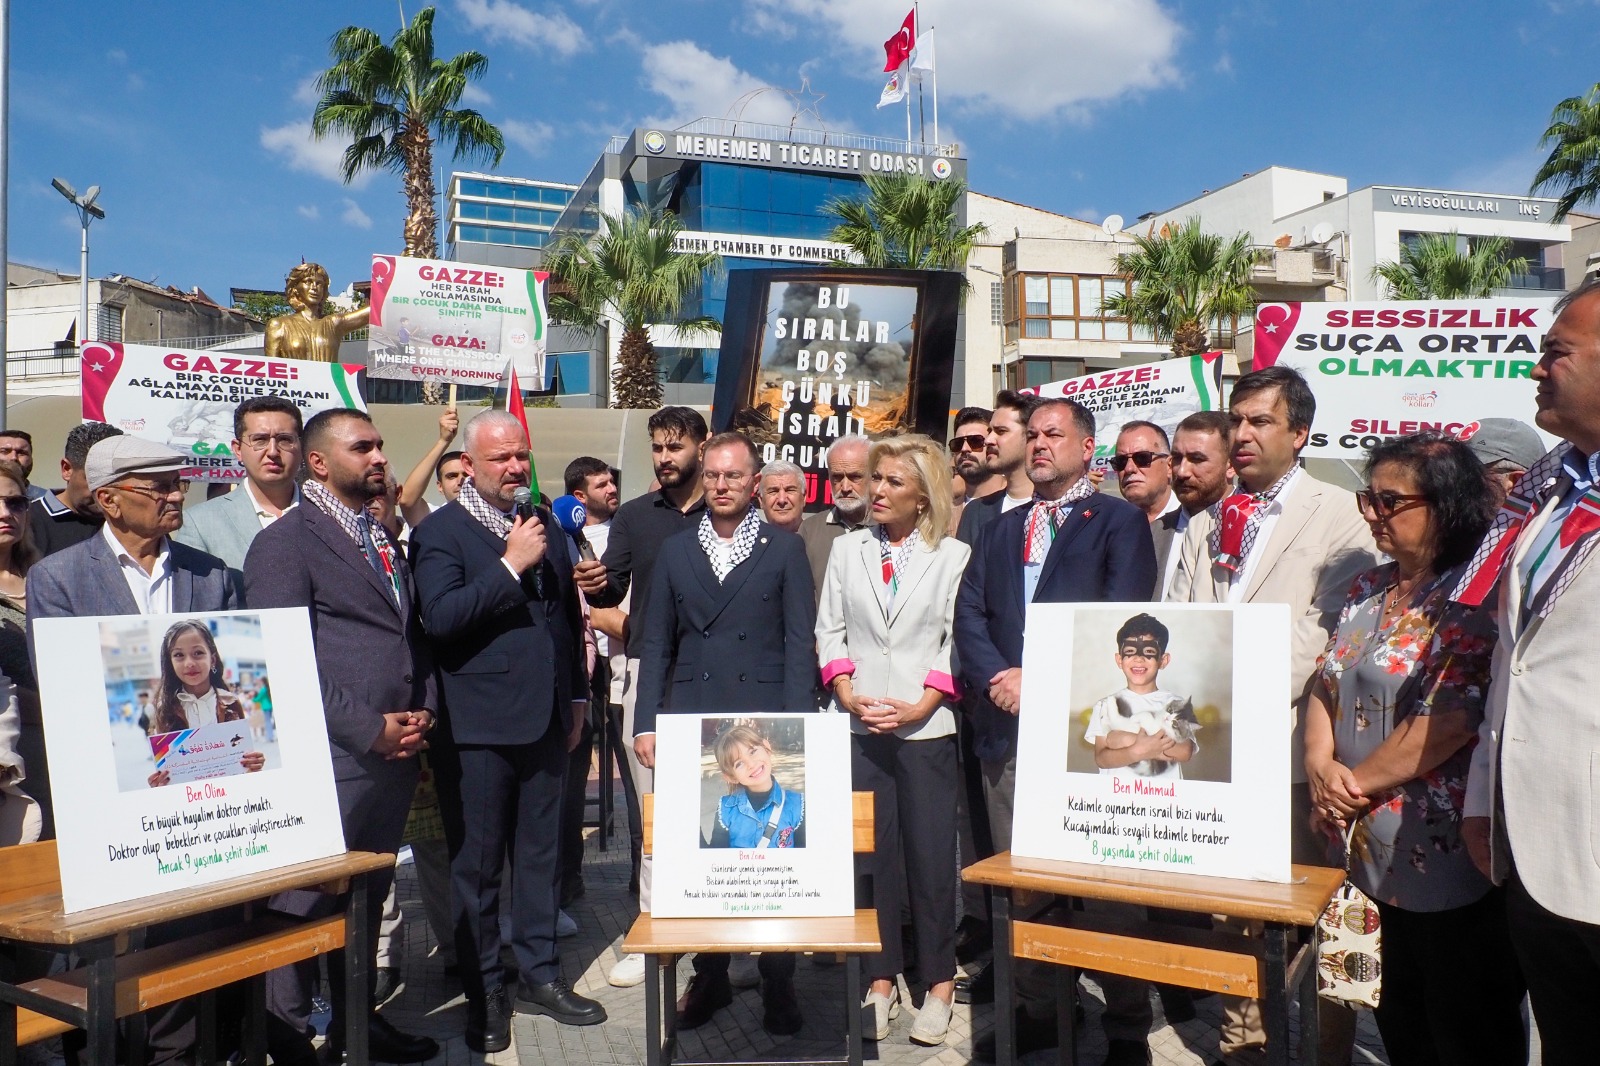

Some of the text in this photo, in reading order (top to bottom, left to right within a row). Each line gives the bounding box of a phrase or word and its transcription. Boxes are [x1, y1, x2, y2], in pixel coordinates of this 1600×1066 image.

[676, 136, 772, 162] MENEMEN
[870, 152, 924, 176] ODASI
[672, 238, 846, 260] NEMEN CHAMBER OF COMMERCE
[419, 266, 504, 288] GAZZE:
[420, 290, 502, 304] YOKLAMASINDA
[431, 282, 490, 295] HER SABAH
[818, 287, 850, 309] BU
[413, 299, 449, 308] ÇOCUK
[452, 302, 482, 310] DAHA
[432, 334, 486, 350] GAZA:
[774, 318, 890, 344] SIRALAR
[405, 346, 510, 361] IS THE CLASSROOM
[1294, 334, 1404, 356] SUÇA
[163, 354, 298, 380] GAZZE:
[375, 354, 416, 364] WHERE
[420, 356, 443, 366] ONE
[797, 350, 846, 380] BOŞ
[209, 374, 288, 388] ÇOCUĞUN
[412, 366, 502, 380] EVERY MORNING
[1062, 366, 1160, 396] GAZZE:
[128, 378, 224, 393] AĞLAMAYA
[268, 388, 330, 400] ZAMANI
[782, 377, 870, 409] ÇÜNKÜ
[1089, 382, 1150, 398] ÇOCUĞUN
[1132, 386, 1185, 399] ZAMANI
[778, 408, 868, 438] İSRAİL
[1350, 418, 1464, 436] SILENC
[186, 783, 228, 803] Ben Olina.
[1113, 777, 1177, 798] Ben Mahmud.
[141, 816, 154, 832] En
[156, 813, 182, 835] büyük
[183, 807, 215, 830] hayalim
[216, 802, 242, 822] doktor
[1068, 795, 1226, 824] Kedimle oynarken israil bizi vurdu.
[108, 838, 140, 862] Doktor
[142, 840, 161, 860] olup
[165, 830, 202, 851] bebekleri
[203, 832, 212, 843] ve
[214, 822, 248, 844] çocukları
[1063, 816, 1230, 846] Kucağımdaki sevgili kedimle beraber
[158, 842, 270, 875] Ancak 9 yaşında şehit oldum.
[740, 850, 750, 860] Ben
[1092, 840, 1196, 865] 8 yaşında şehit oldum.
[739, 866, 756, 876] yemek
[722, 902, 728, 911] 10
